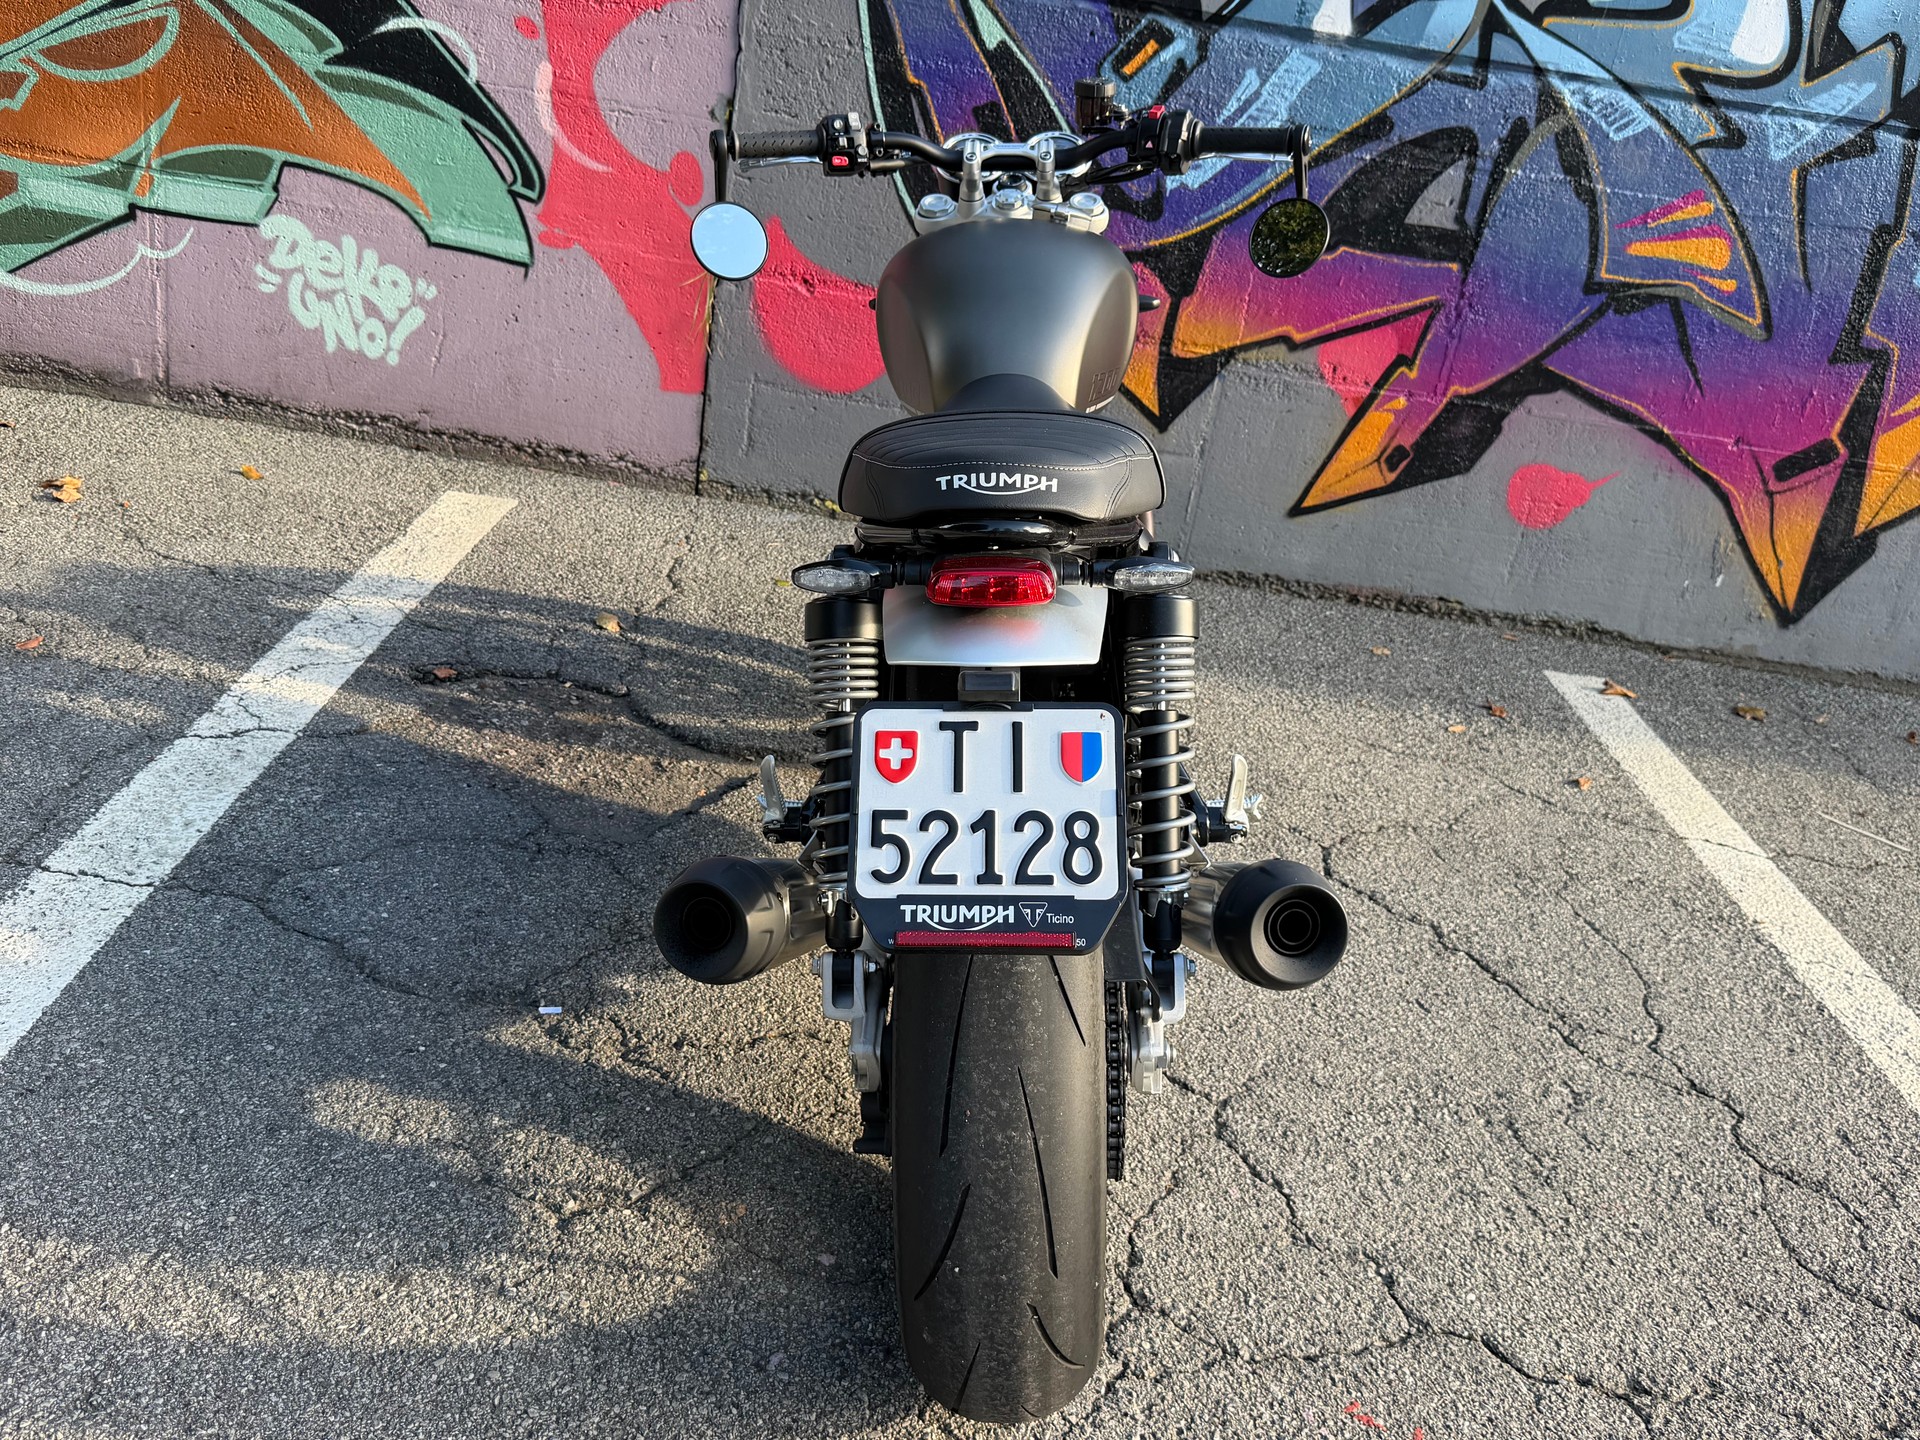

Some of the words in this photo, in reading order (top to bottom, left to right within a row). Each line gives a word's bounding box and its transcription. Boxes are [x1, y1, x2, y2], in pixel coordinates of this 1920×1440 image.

[936, 472, 1058, 495] TRIUMPH
[870, 809, 1103, 885] 52128
[900, 905, 1015, 931] TRIUMPH
[1046, 913, 1075, 924] Ticino
